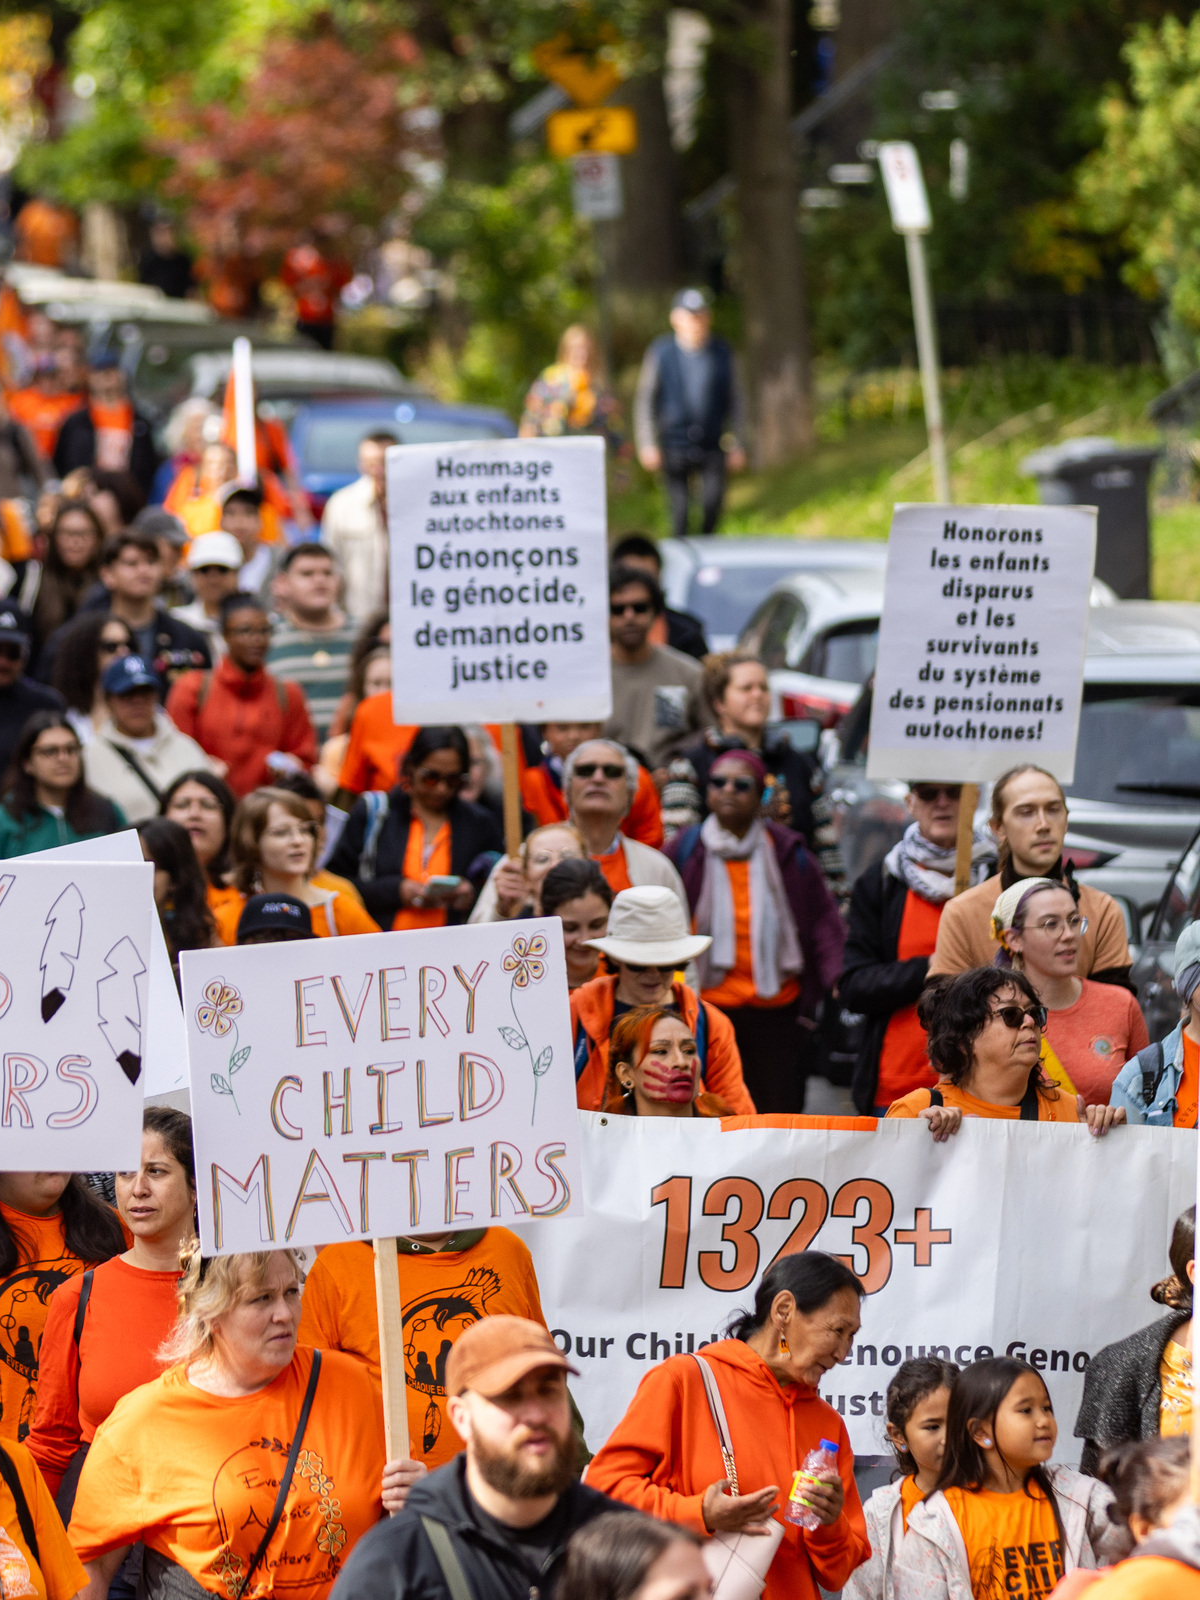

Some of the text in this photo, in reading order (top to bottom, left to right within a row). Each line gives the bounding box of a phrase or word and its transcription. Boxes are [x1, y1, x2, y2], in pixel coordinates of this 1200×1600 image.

[436, 457, 553, 480] Hommage
[430, 483, 560, 506] aux enfants
[426, 511, 565, 533] autochtones
[943, 520, 1043, 543] Honorons
[415, 542, 579, 575] Dénonçons
[931, 548, 1049, 572] les enfants
[410, 576, 585, 613] le génocide,
[942, 577, 1034, 603] disparus
[957, 607, 1015, 627] et les
[415, 617, 583, 648] demandons
[927, 635, 1039, 656] survivants
[450, 654, 548, 690] justice
[919, 661, 1041, 688] du système
[890, 689, 1063, 715] des pensionnats
[906, 720, 1043, 740] autochtones!
[294, 960, 489, 1047] EVERY
[270, 1051, 505, 1140] CHILD
[211, 1141, 571, 1252] MATTERS
[650, 1175, 952, 1295] 1323+
[550, 1329, 615, 1358] Our
[6, 1354, 30, 1376] EVERY
[407, 1377, 448, 1395] CHAQUE EN
[818, 1390, 883, 1416] ust
[1003, 1540, 1062, 1569] EVER
